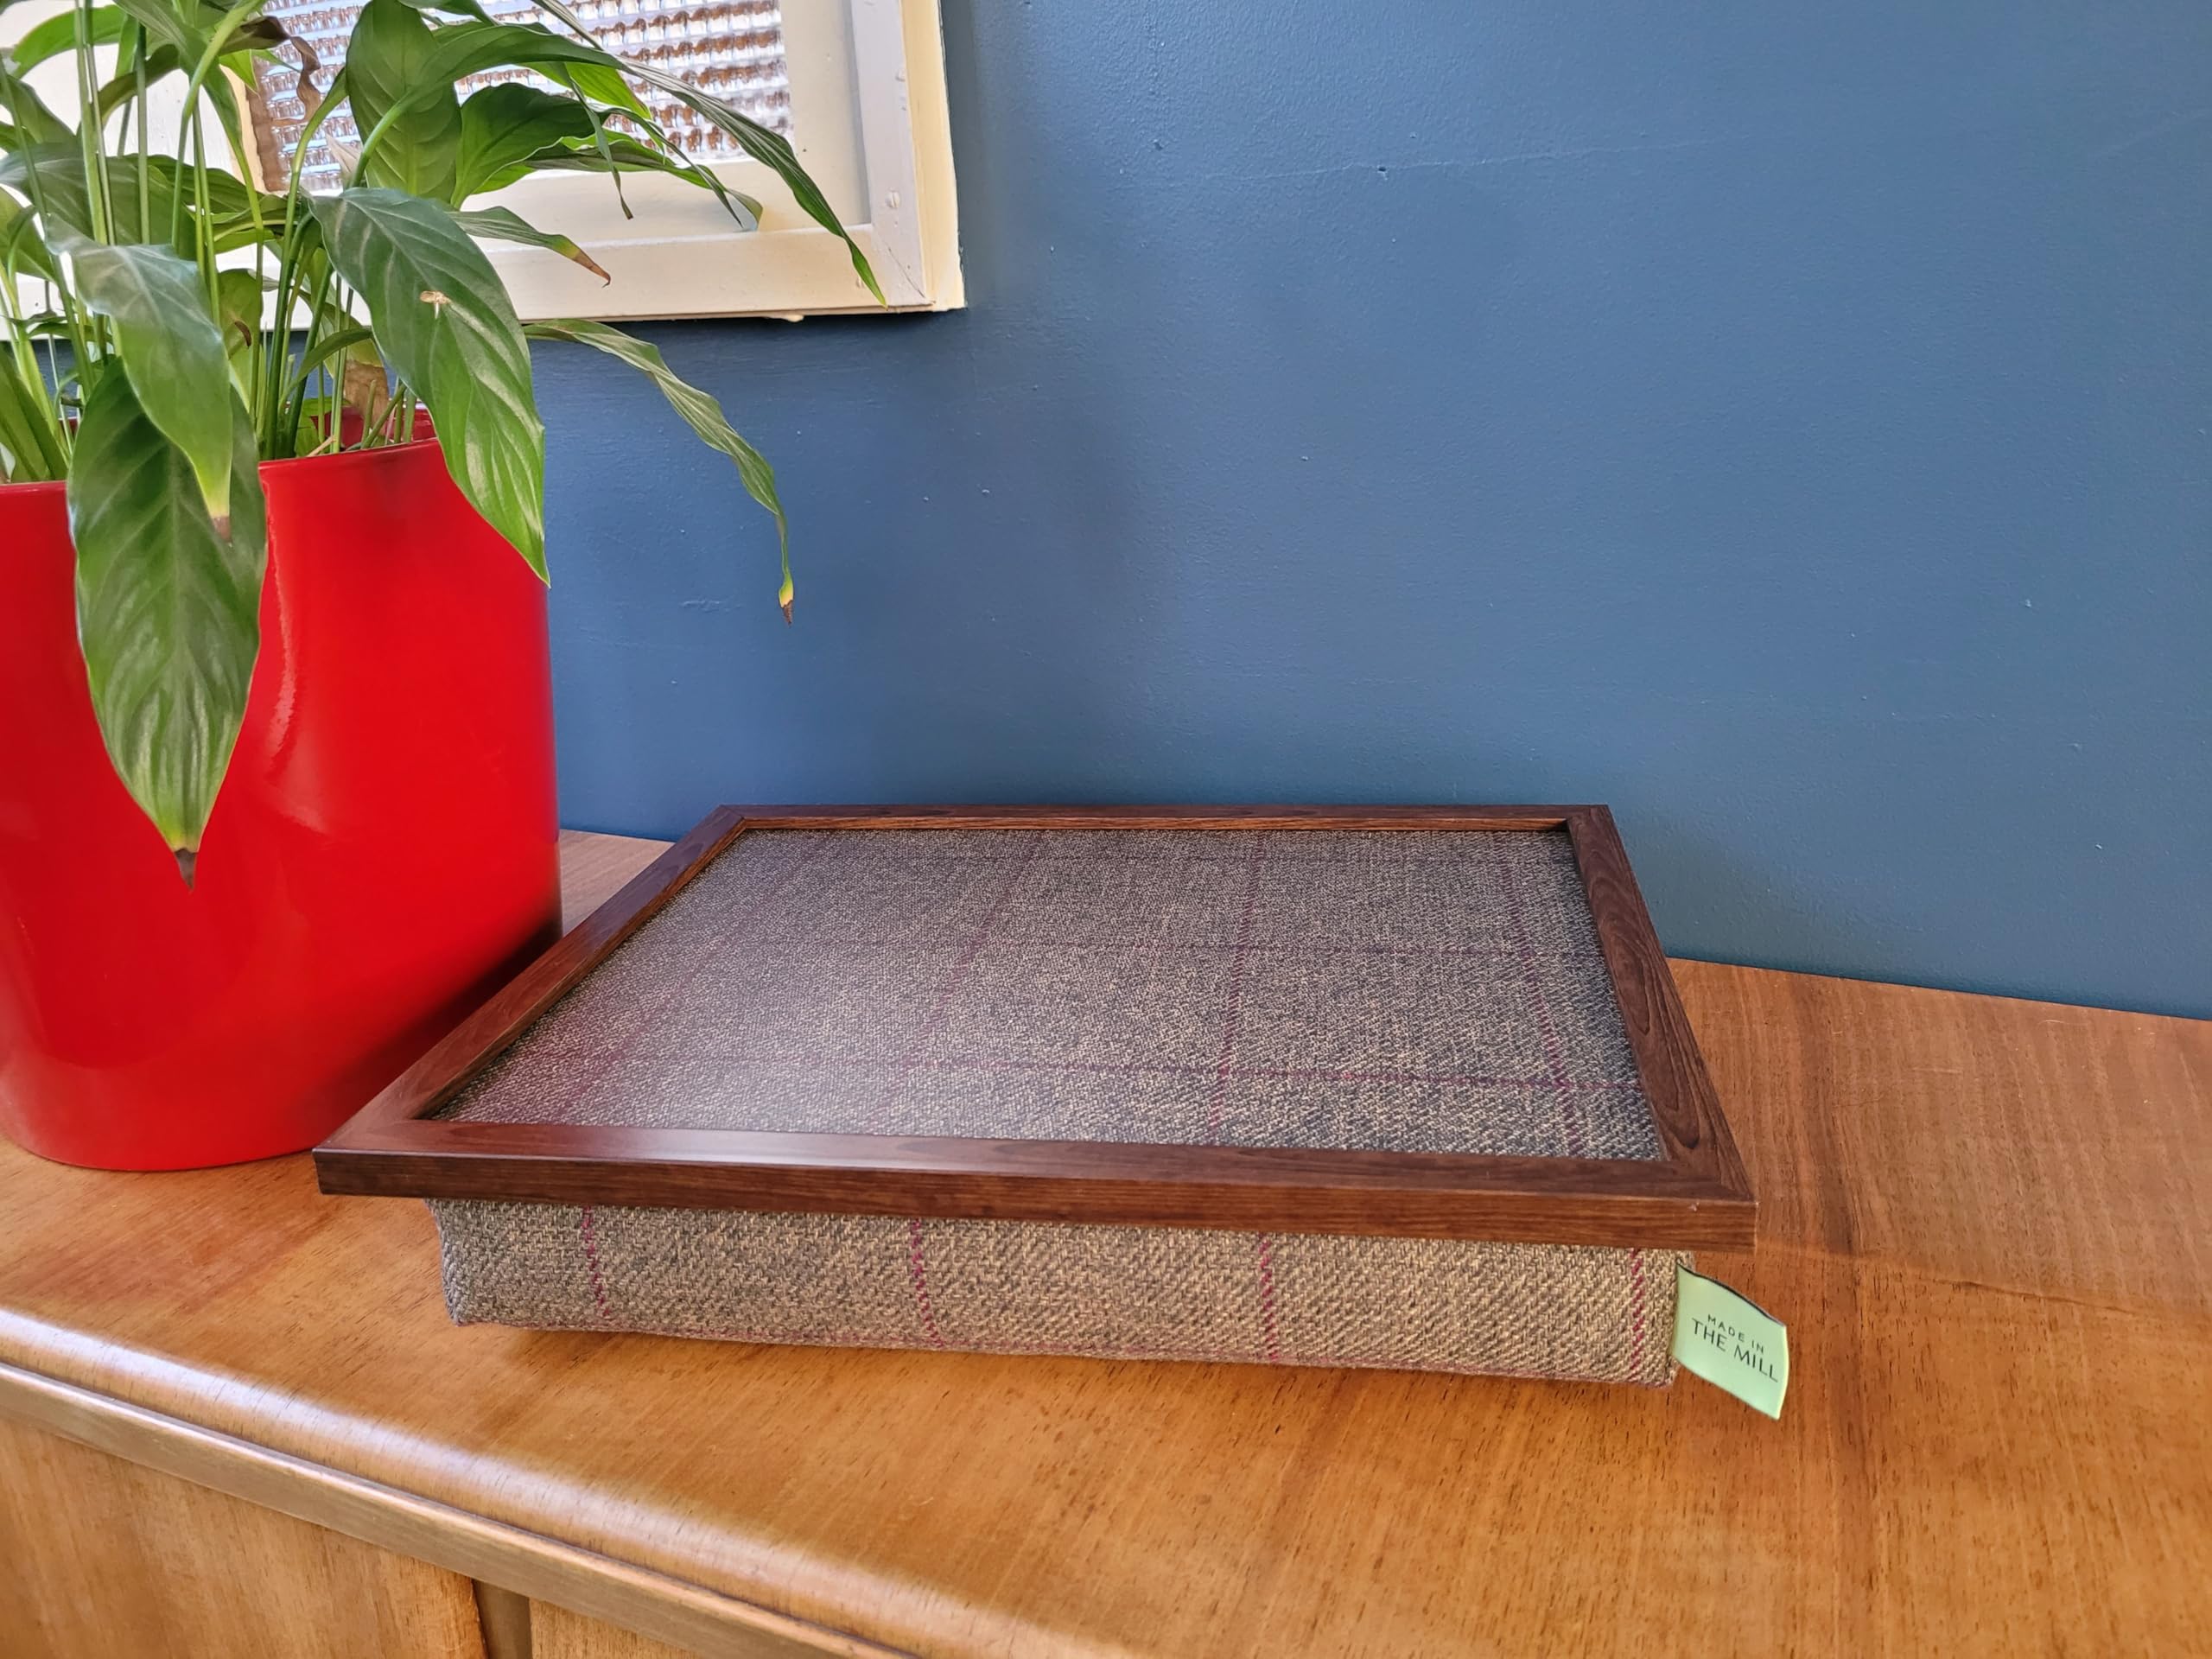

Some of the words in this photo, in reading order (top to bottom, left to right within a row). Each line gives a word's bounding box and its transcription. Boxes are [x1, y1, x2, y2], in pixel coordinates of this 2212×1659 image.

[1692, 1317, 1727, 1351] THE
[1733, 1344, 1778, 1383] MILL
[1707, 1313, 1745, 1343] MADE
[1751, 1340, 1764, 1354] IN
